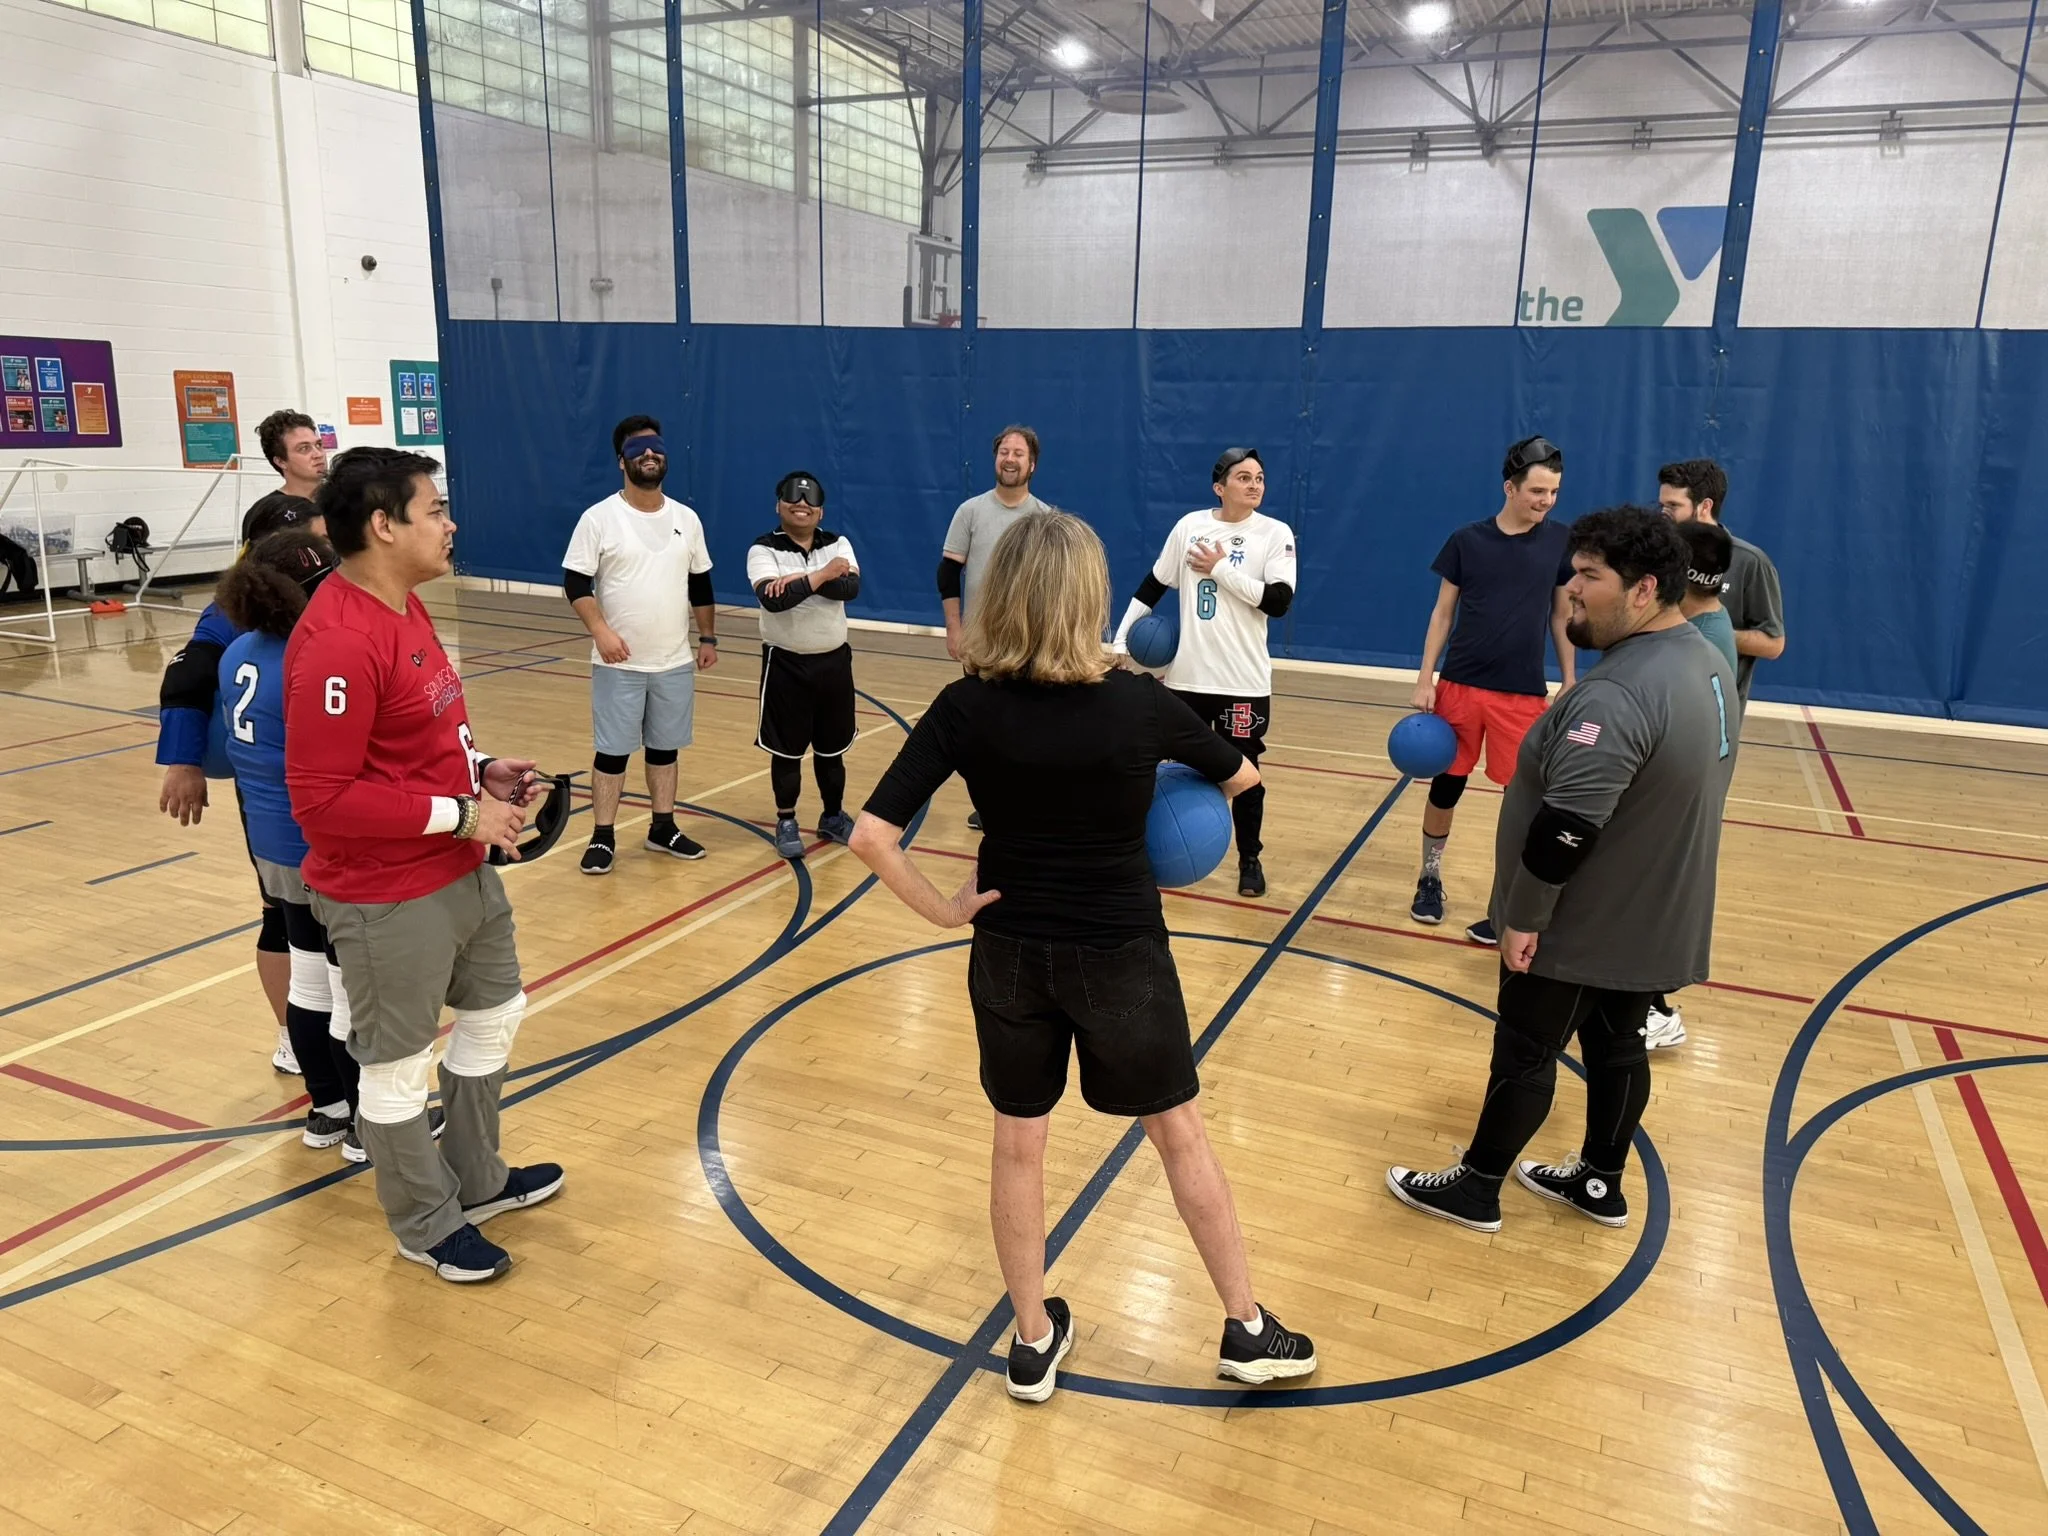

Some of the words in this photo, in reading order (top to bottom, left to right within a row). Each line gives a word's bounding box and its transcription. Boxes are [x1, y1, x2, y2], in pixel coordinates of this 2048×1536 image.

[1519, 286, 1584, 322] the
[1197, 578, 1217, 620] 6
[233, 661, 260, 745] 2
[324, 675, 347, 716] 6
[1710, 672, 1730, 761] 1
[457, 720, 482, 797] 6
[1267, 1330, 1298, 1360] N
